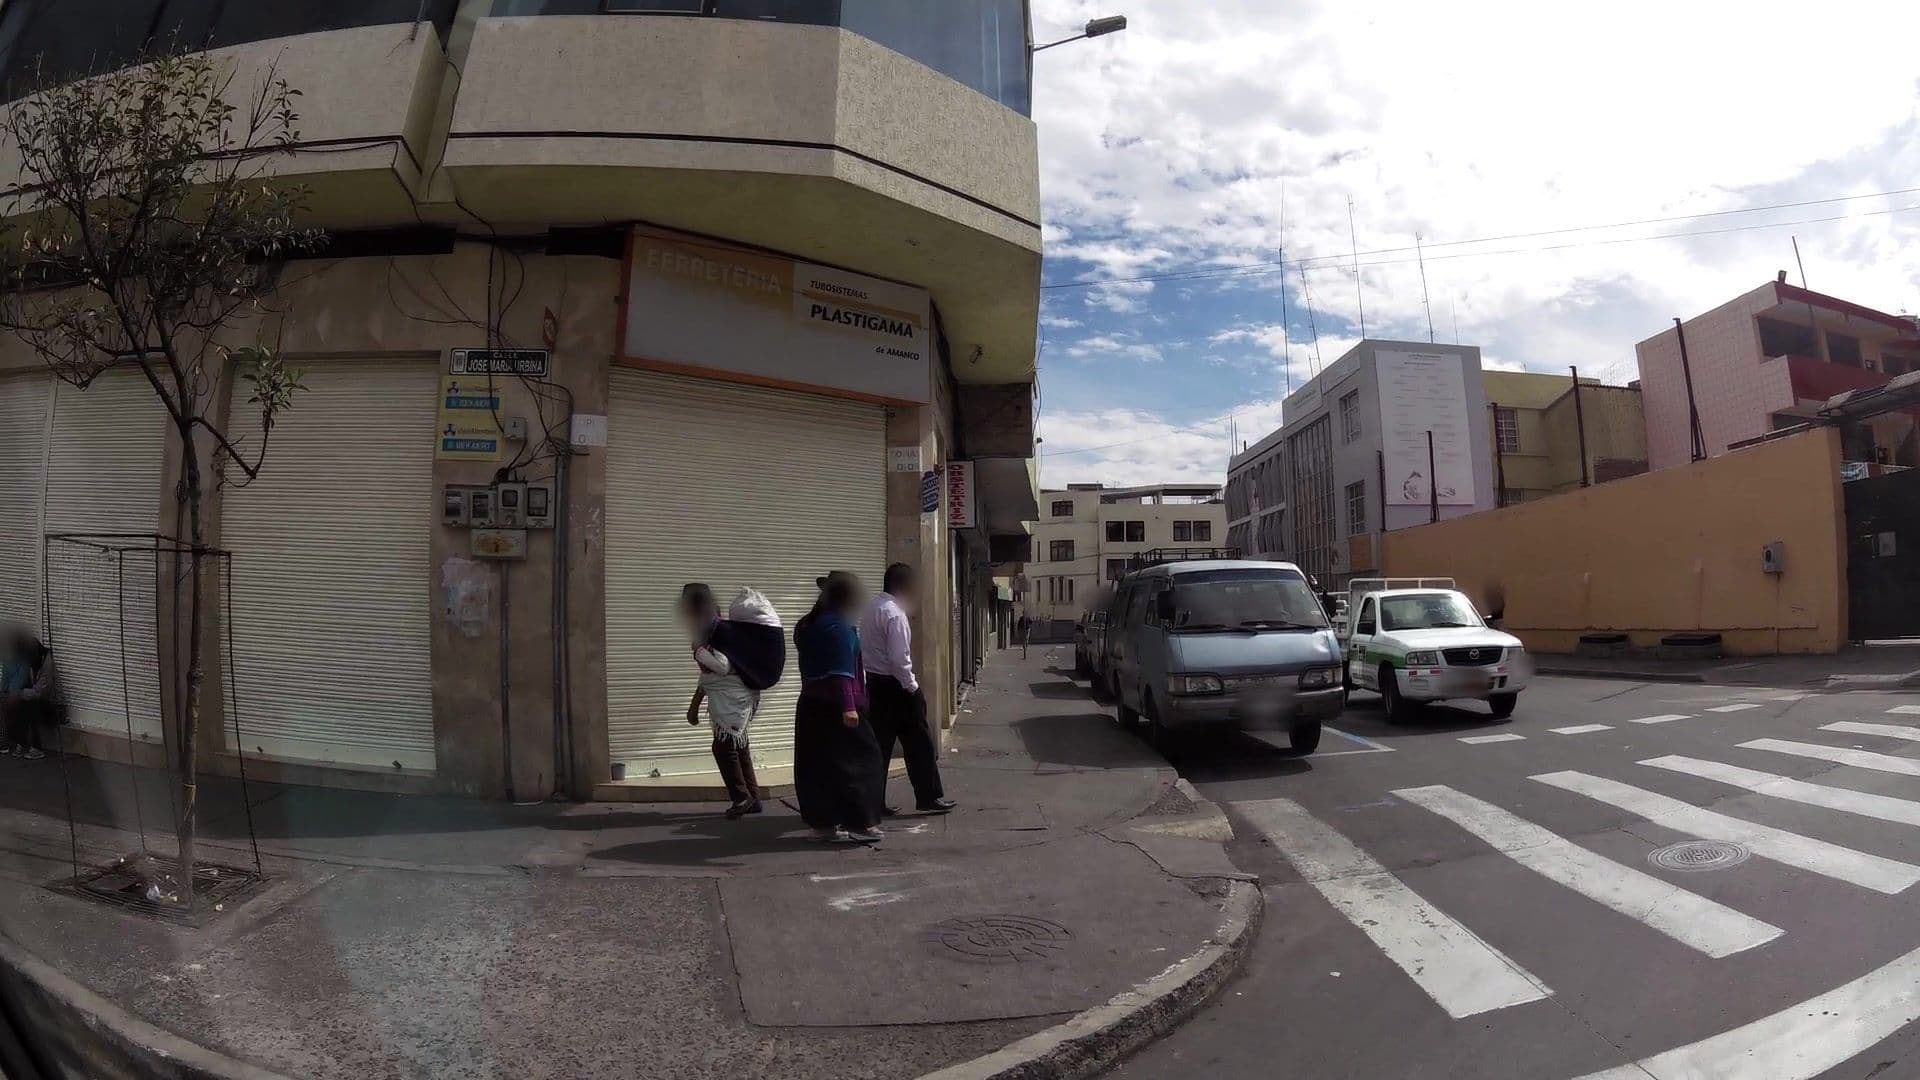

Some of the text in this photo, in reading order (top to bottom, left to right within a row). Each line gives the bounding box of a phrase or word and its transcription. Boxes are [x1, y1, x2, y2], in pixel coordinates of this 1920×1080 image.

[647, 248, 783, 297] FERRETERIA
[810, 280, 868, 300] TUBOSISTEMAS
[810, 304, 914, 338] PLASTIGAMA
[875, 346, 920, 361] de AMANCO
[468, 359, 488, 372] JOSE
